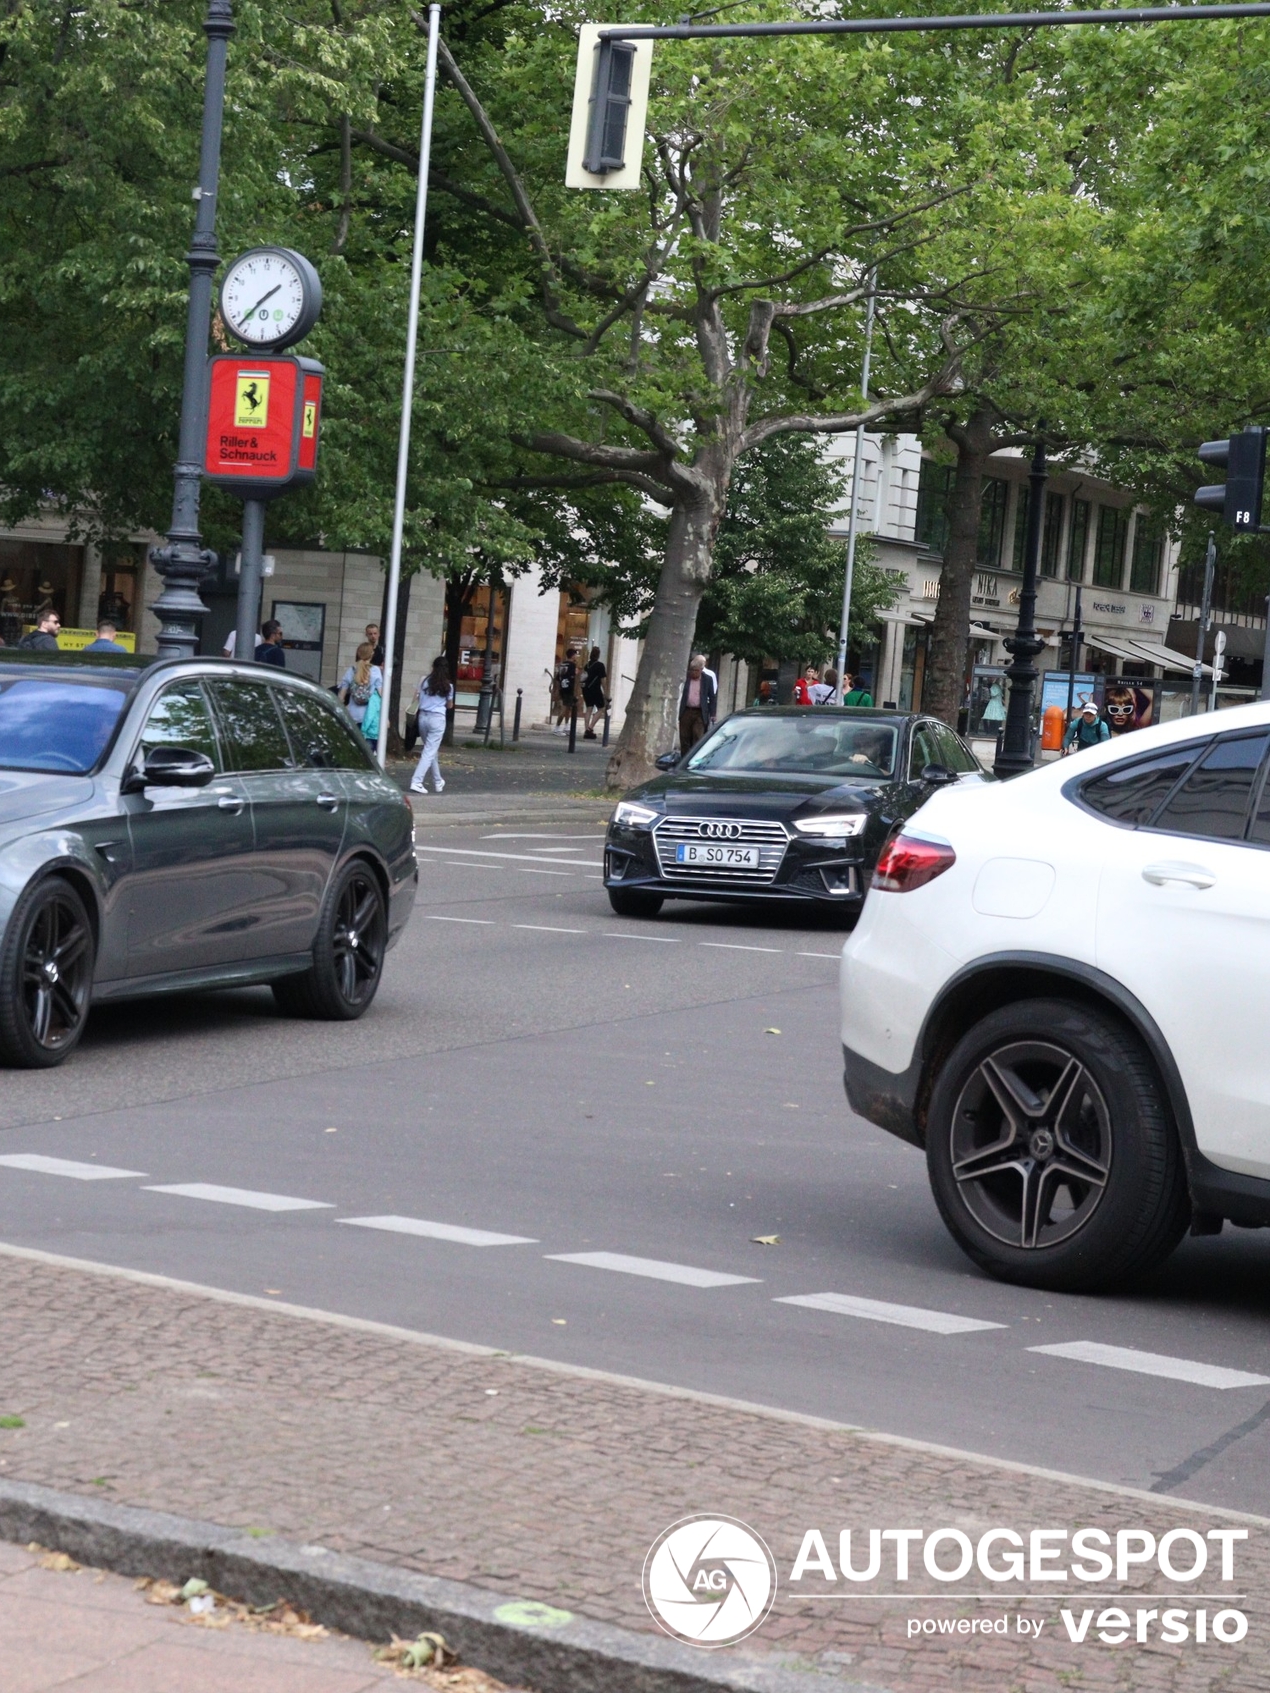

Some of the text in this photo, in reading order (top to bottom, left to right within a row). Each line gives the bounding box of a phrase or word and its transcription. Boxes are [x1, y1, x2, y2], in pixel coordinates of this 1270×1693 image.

[237, 416, 264, 425] Ferrari
[220, 435, 258, 449] Riller &
[219, 447, 277, 462] Schnauck
[1235, 510, 1251, 524] F8
[976, 574, 998, 597] NIKA
[457, 650, 471, 665] E
[689, 847, 752, 863] B SO 754
